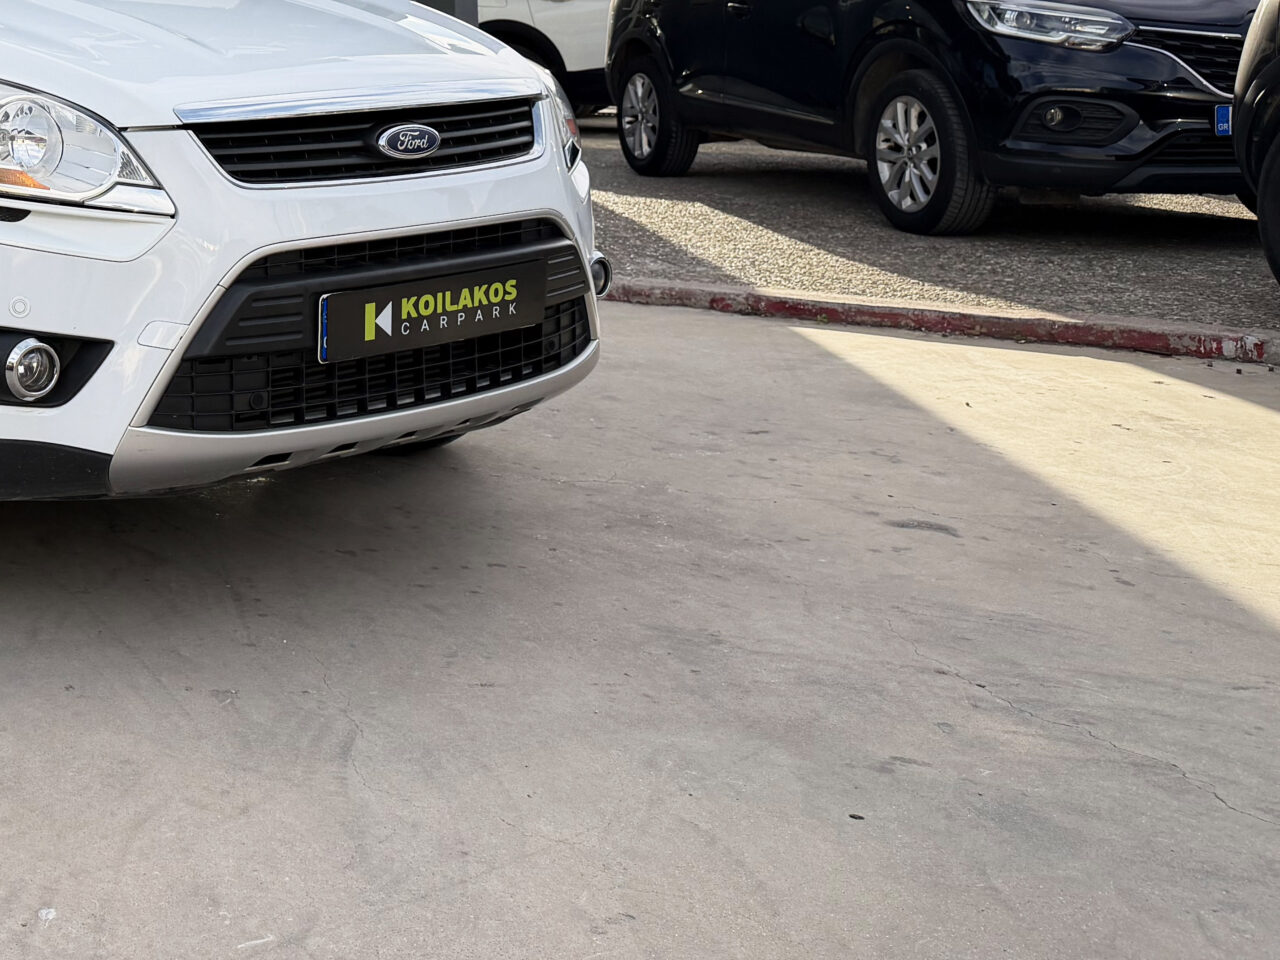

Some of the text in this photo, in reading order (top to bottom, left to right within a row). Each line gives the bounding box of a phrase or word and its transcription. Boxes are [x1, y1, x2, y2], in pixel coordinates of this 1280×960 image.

[397, 131, 429, 150] Ford
[401, 279, 518, 319] KOILAKOS
[401, 302, 517, 336] CARPARK
